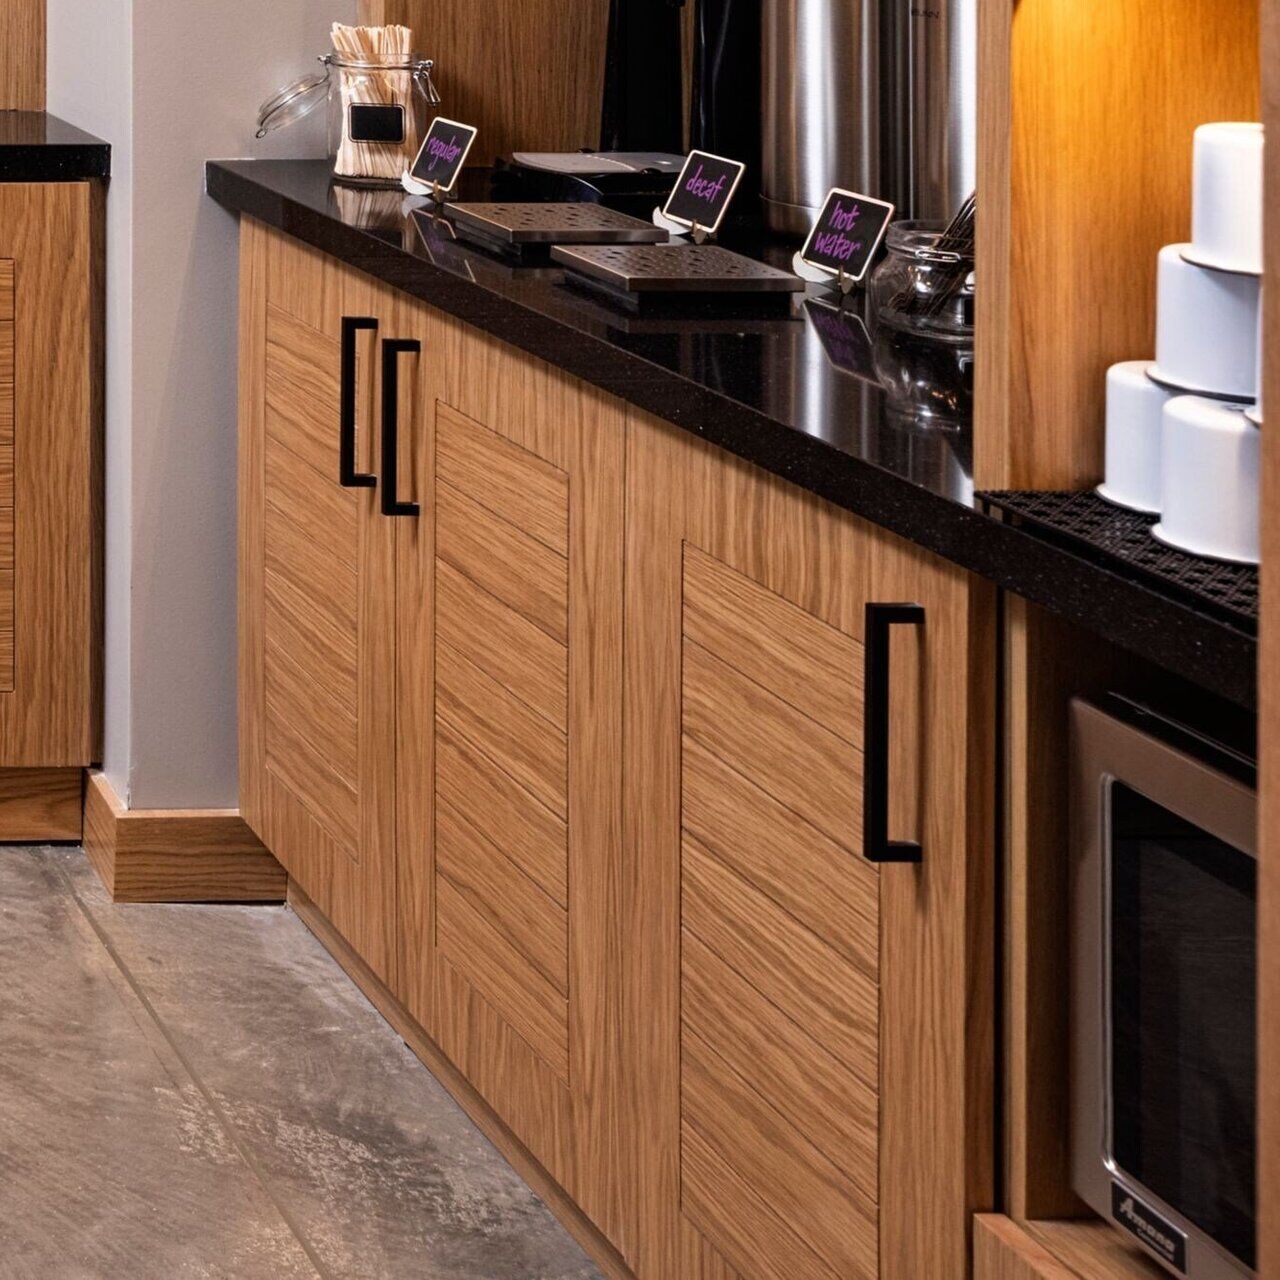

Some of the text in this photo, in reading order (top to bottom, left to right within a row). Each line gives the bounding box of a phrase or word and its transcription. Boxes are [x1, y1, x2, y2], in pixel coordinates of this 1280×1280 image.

[427, 135, 462, 171] regular
[685, 163, 728, 204] decaf
[830, 200, 860, 231] hot
[813, 229, 863, 261] water
